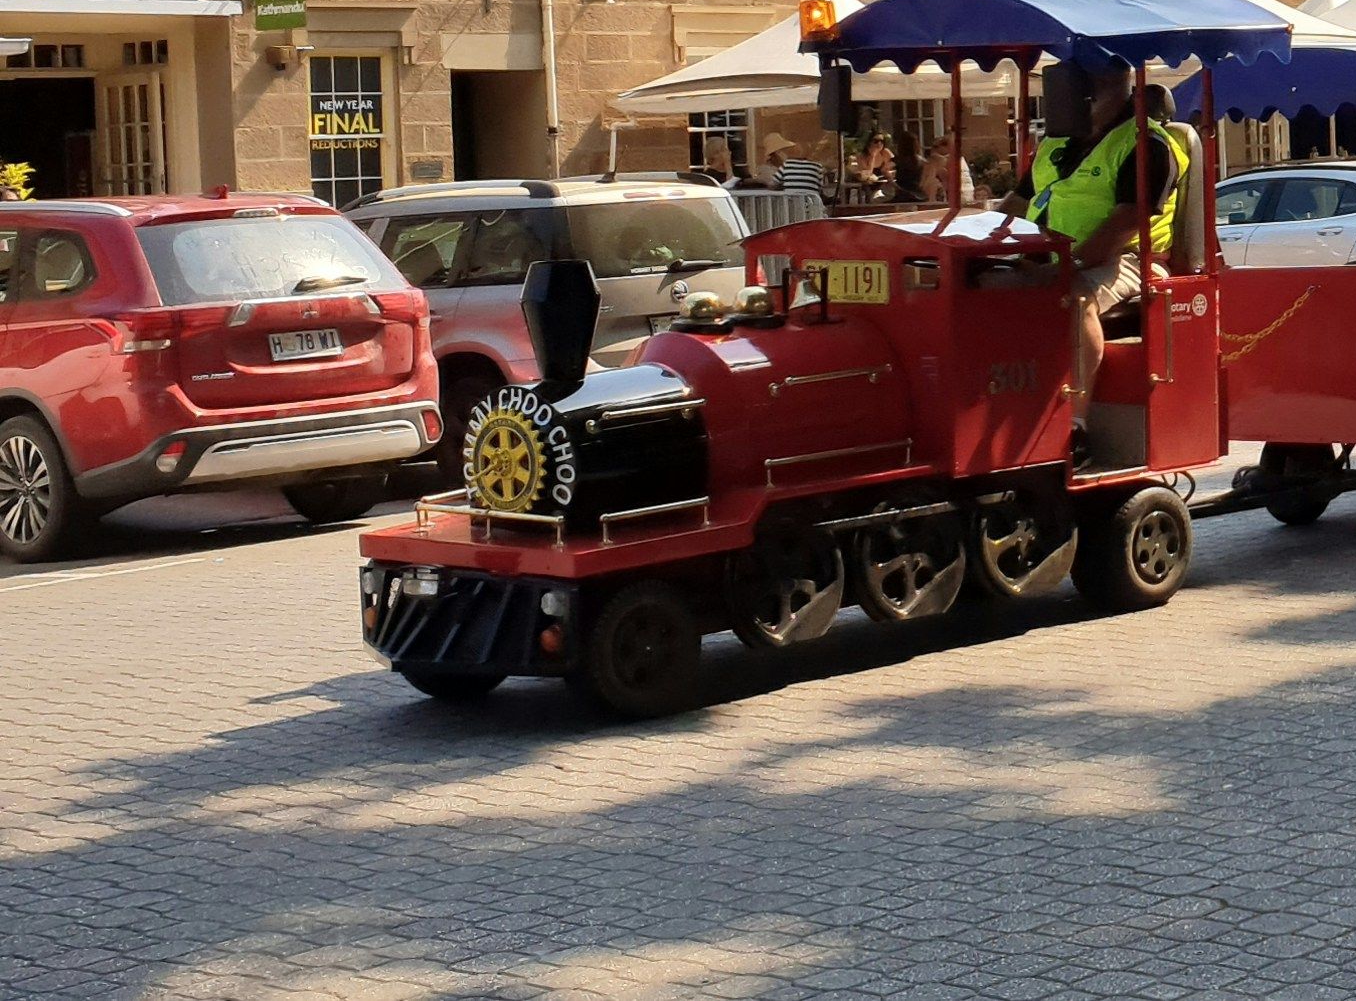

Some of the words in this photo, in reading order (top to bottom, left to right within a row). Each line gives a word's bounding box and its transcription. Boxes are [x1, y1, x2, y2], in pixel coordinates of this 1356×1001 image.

[257, 0, 305, 16] Kathmandu
[320, 101, 343, 110] NEW
[345, 100, 374, 109] YEAR
[313, 112, 380, 135] FINAL
[311, 139, 379, 150] REDUCTIONS
[1170, 302, 1192, 313] otary
[271, 337, 283, 354] H
[498, 388, 552, 426] CHOO
[548, 425, 576, 505] CHOO
